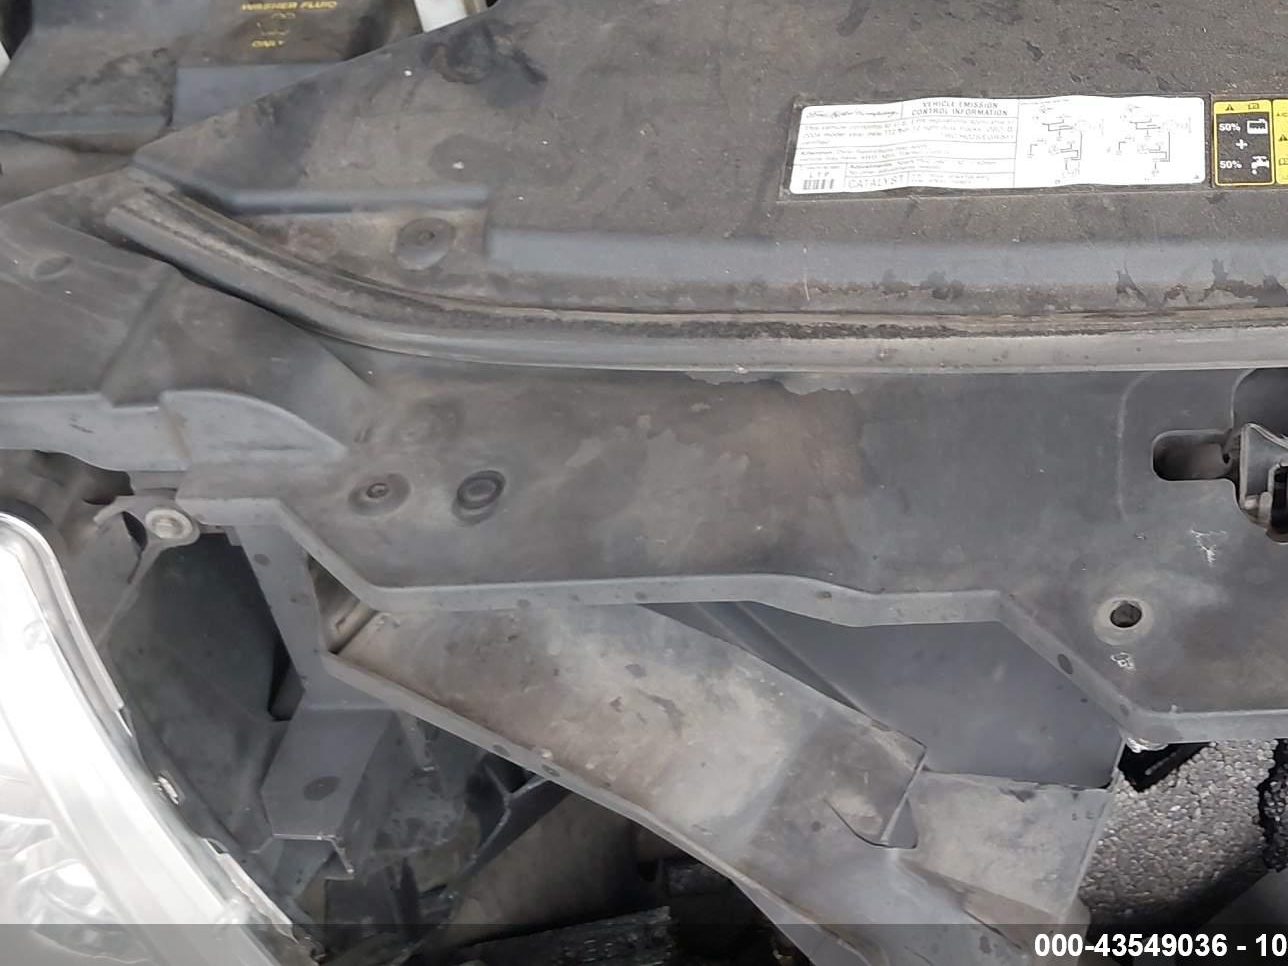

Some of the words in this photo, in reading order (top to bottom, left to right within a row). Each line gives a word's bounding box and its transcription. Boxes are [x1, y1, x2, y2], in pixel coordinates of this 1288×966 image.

[241, 2, 298, 11] WASHER
[300, 1, 337, 9] FLUID
[922, 101, 955, 109] VEHICLE
[958, 101, 999, 109] EMISSION
[911, 108, 950, 116] CONTROL
[952, 108, 1009, 116] INFORMATION
[1219, 122, 1241, 132] 50%
[1220, 160, 1242, 170] 50%
[850, 176, 904, 189] CATALYST
